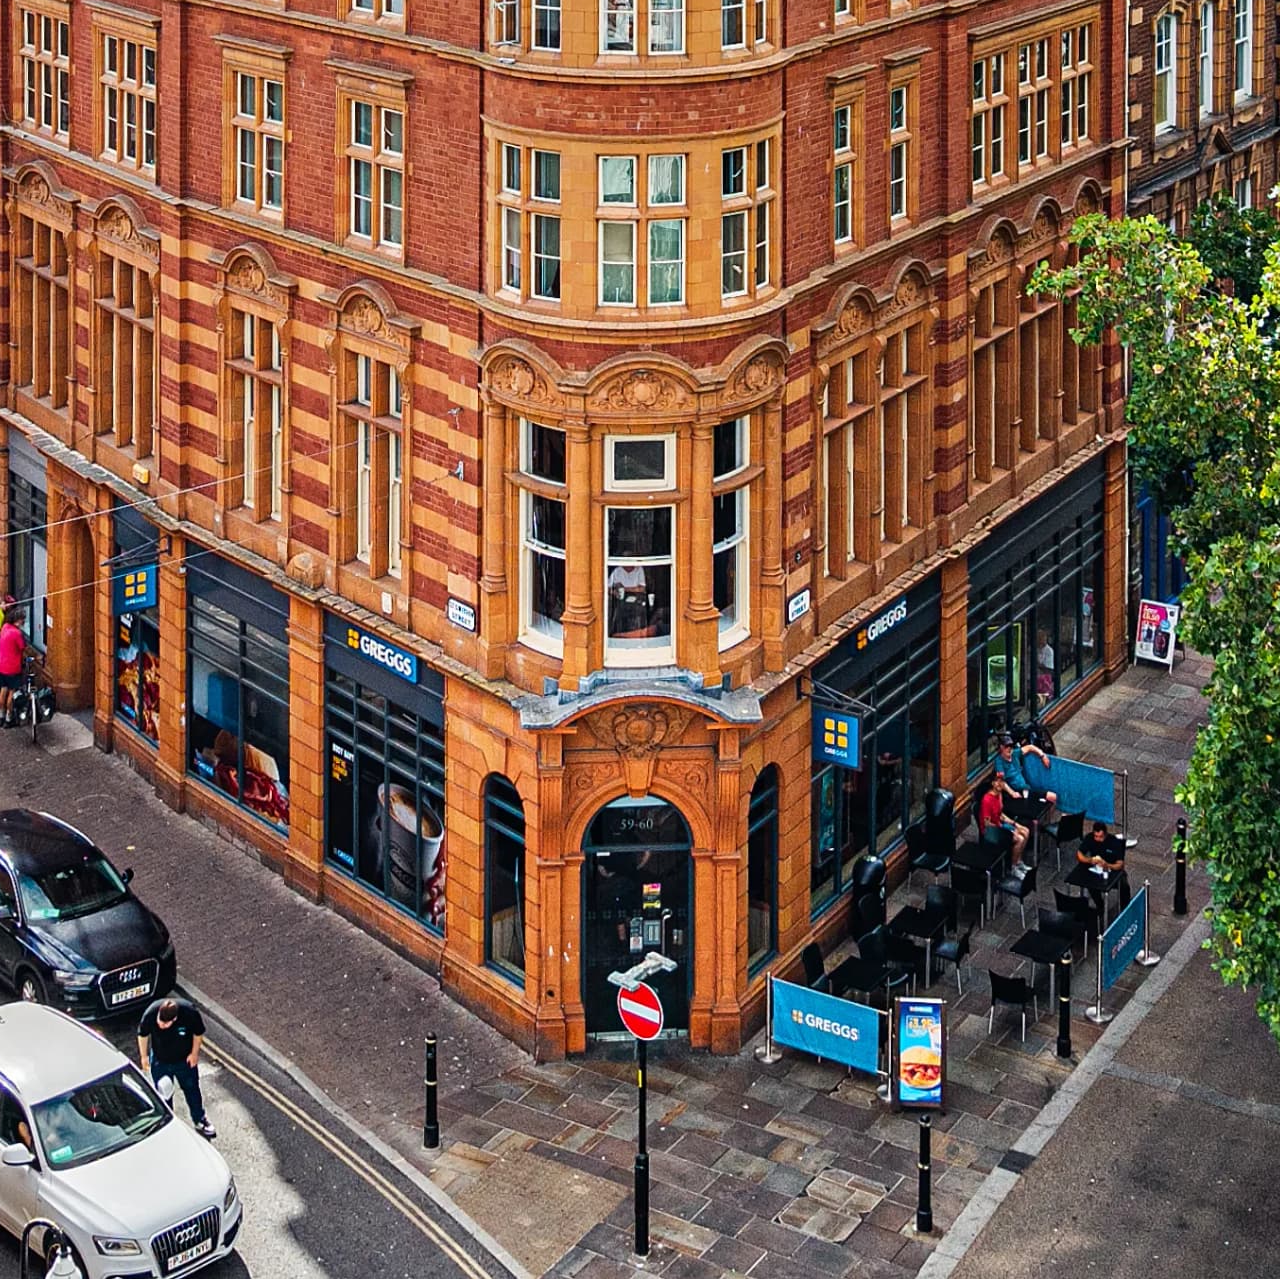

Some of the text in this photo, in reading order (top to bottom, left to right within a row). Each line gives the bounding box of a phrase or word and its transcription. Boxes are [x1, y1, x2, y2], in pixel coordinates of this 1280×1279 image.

[867, 600, 907, 640] GREGGS
[360, 635, 412, 676] GREGGS
[620, 817, 654, 830] 59-60
[805, 1013, 860, 1041] GREGGS
